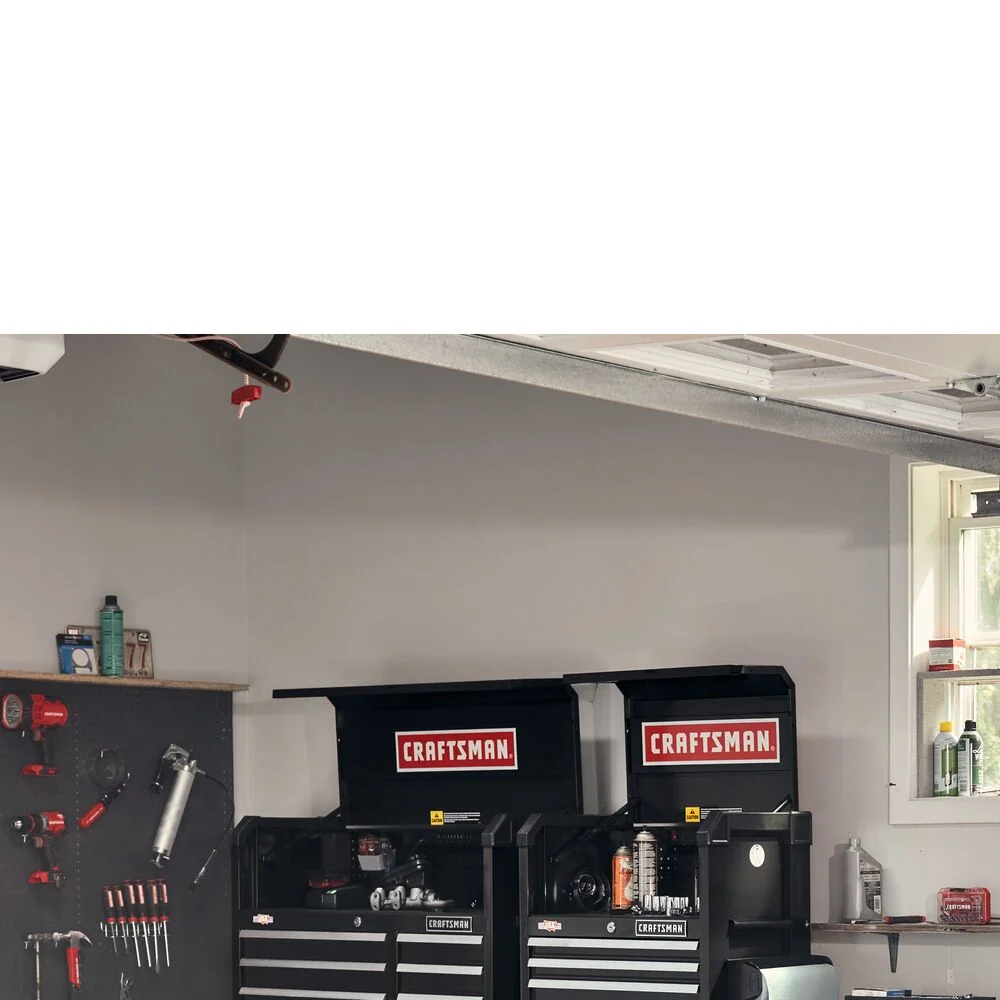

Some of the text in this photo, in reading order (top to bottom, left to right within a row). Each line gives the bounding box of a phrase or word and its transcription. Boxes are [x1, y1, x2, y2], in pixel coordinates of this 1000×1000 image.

[650, 730, 770, 754] CRAFTSMAN
[403, 739, 508, 762] CRAFTSMAN
[429, 919, 469, 929] CRAFTSMAN
[638, 923, 683, 933] CRAFTSMAN
